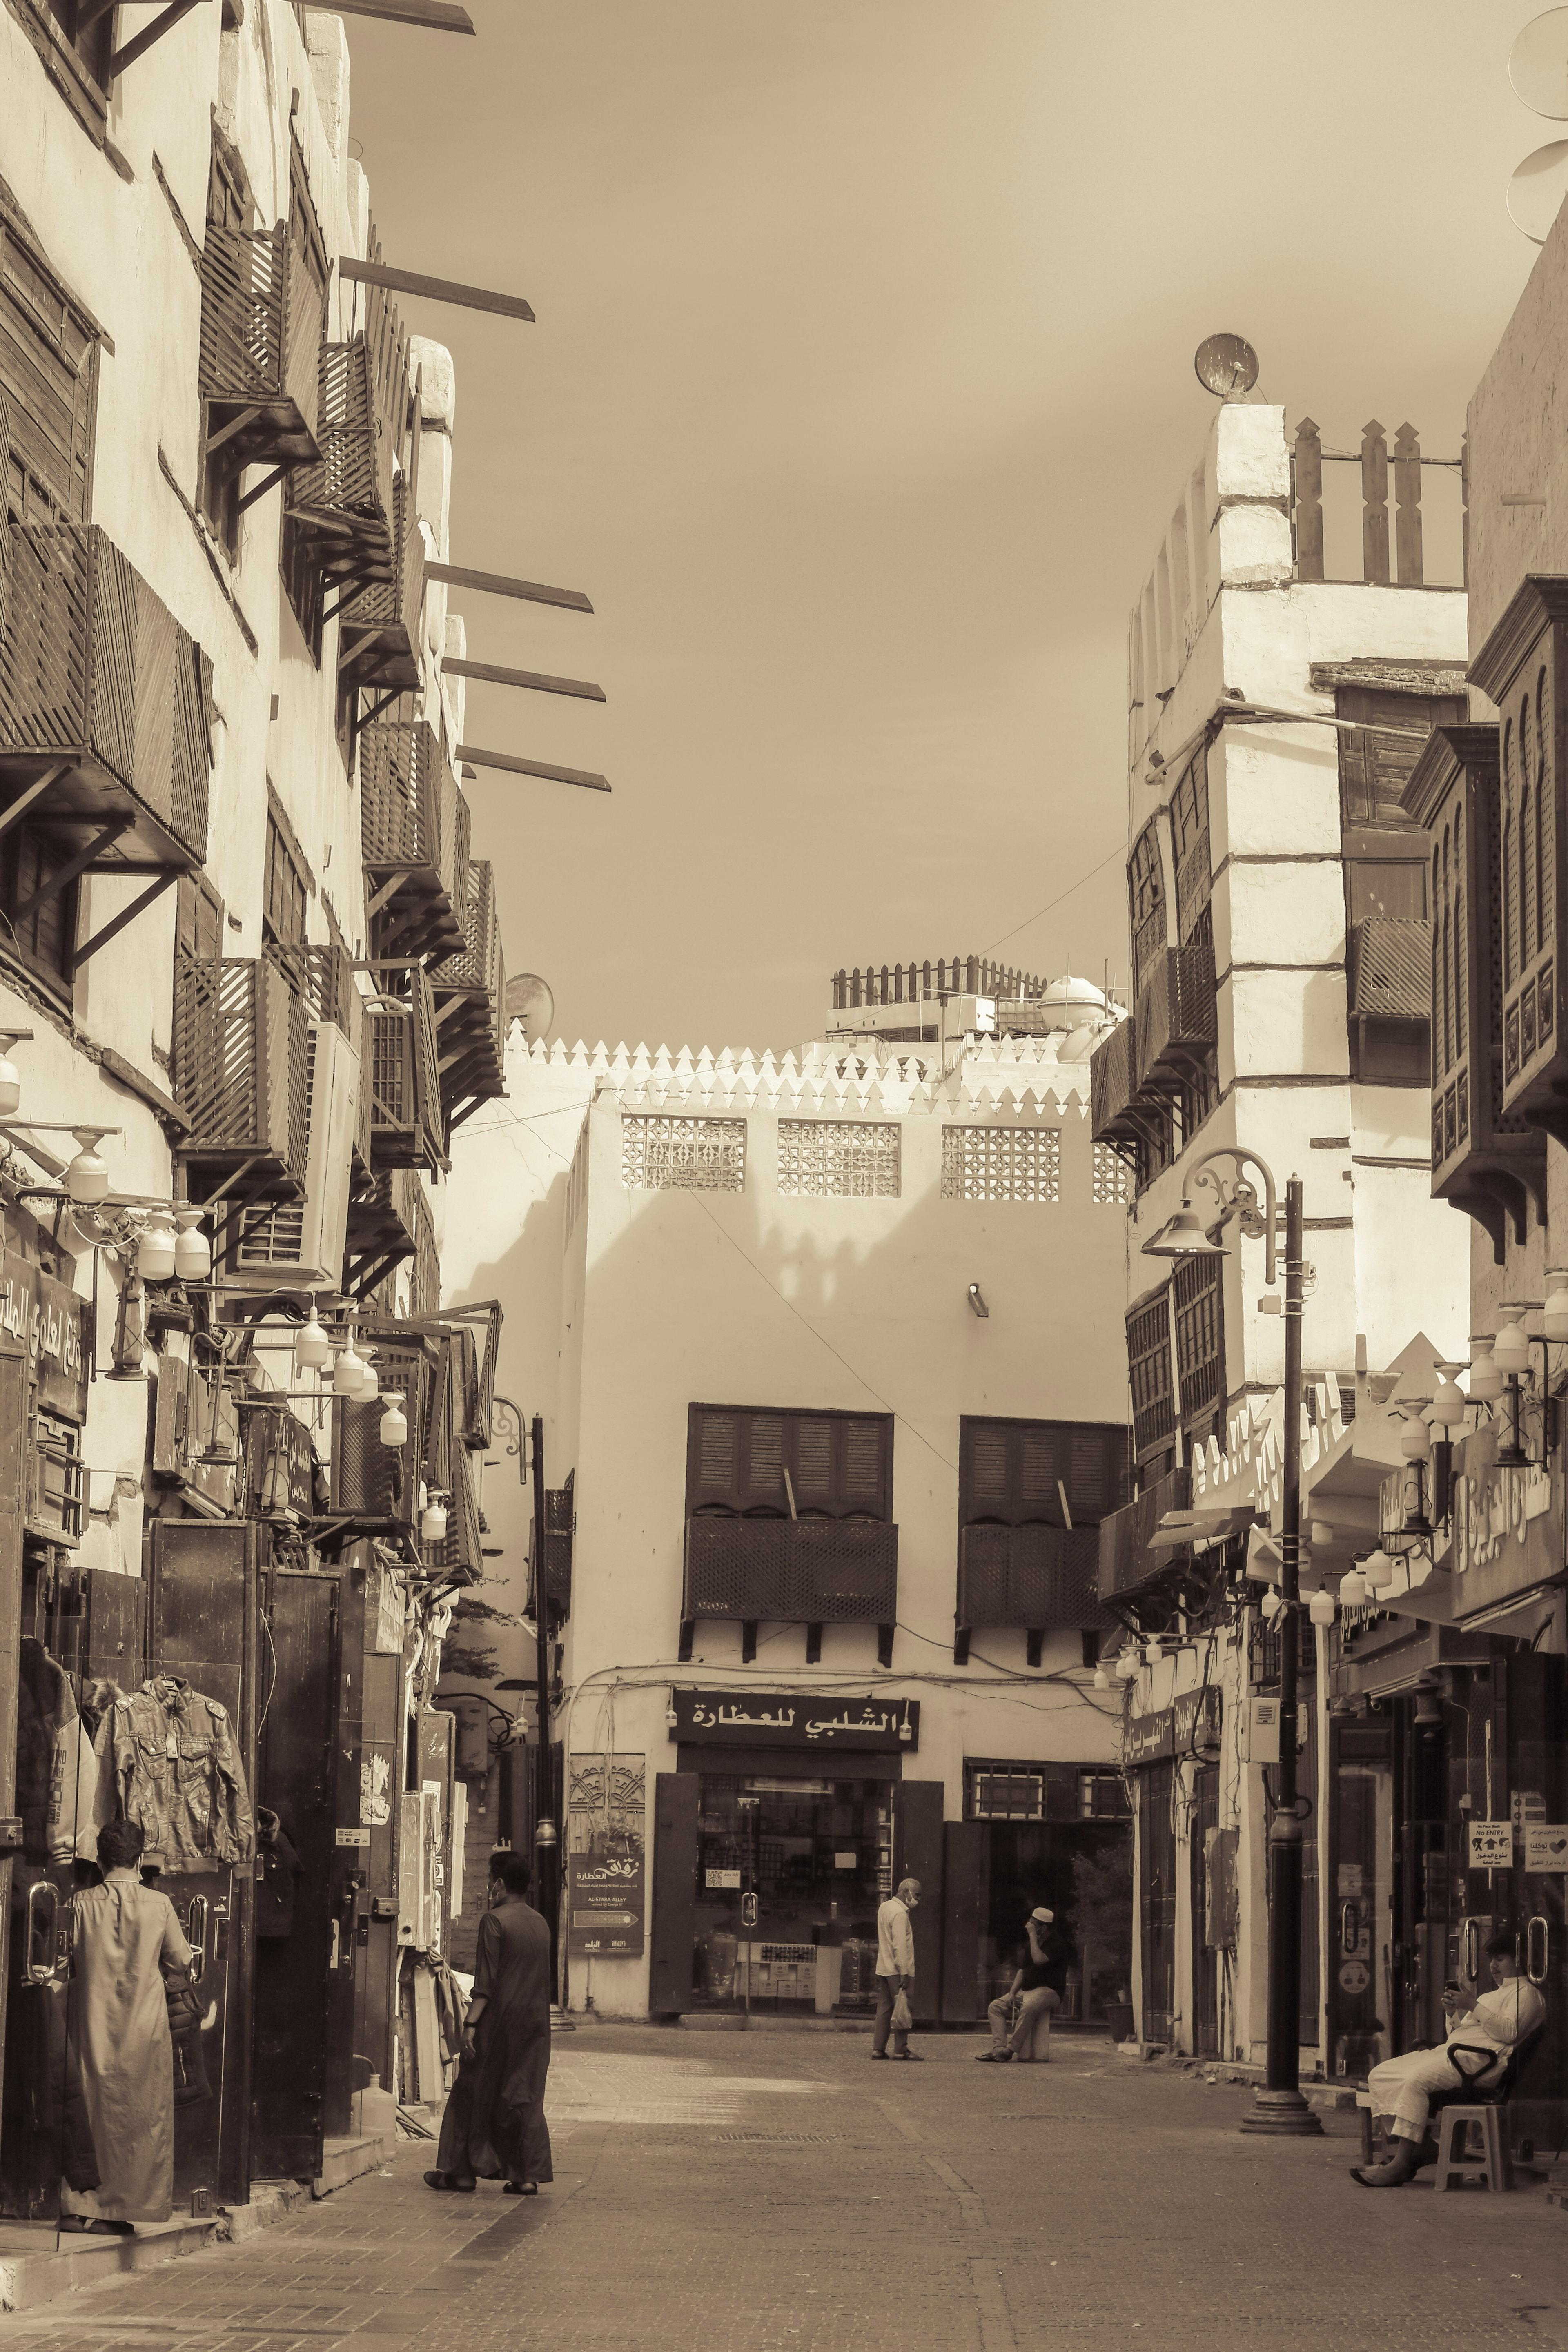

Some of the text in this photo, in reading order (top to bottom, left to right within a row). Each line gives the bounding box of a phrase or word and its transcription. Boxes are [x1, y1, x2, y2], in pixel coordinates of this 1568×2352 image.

[692, 1704, 896, 1739] الشلبي للعطارة
[577, 1872, 606, 1880] العطارة
